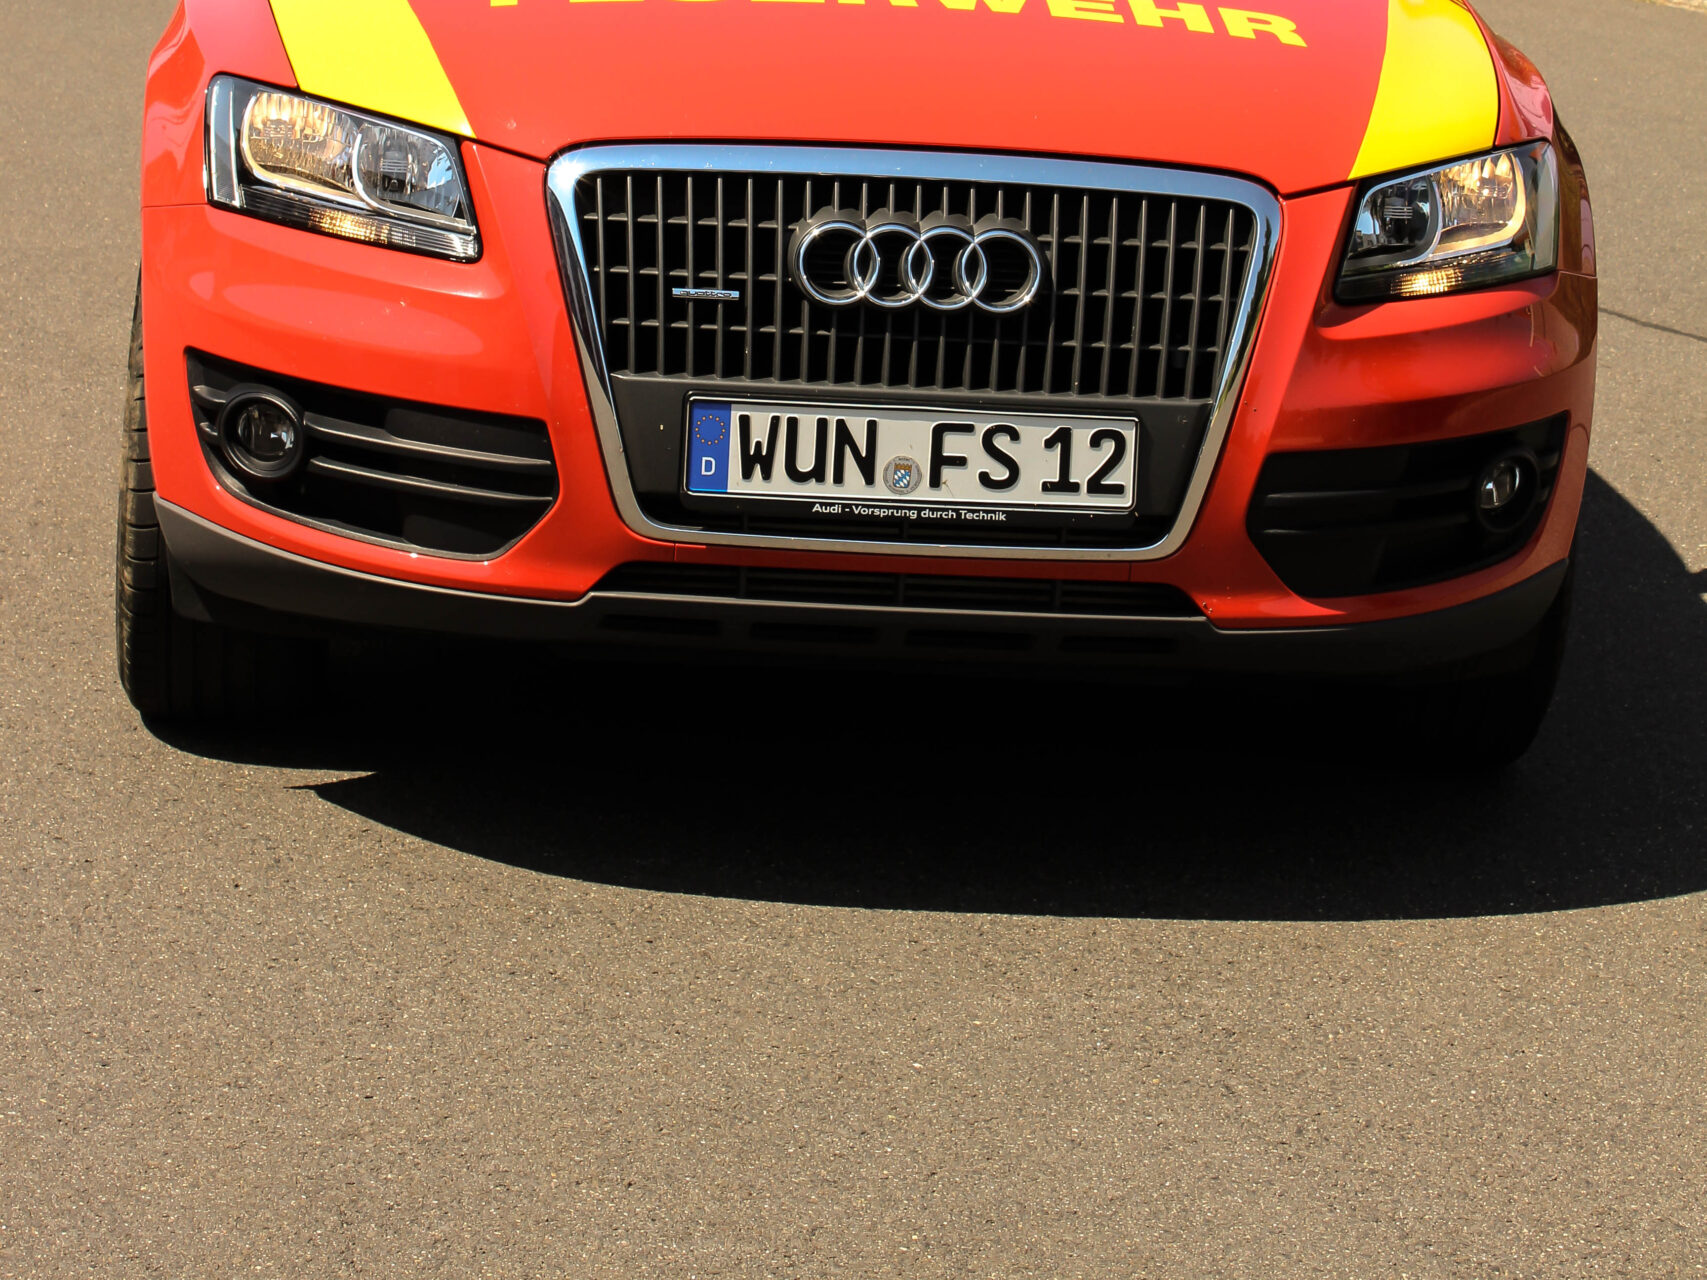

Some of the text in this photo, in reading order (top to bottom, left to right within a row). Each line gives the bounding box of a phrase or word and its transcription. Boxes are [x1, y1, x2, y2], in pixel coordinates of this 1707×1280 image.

[679, 289, 733, 298] quattro
[737, 413, 878, 485] WUN
[928, 422, 1021, 490] FS
[1040, 425, 1127, 495] 12
[701, 456, 716, 476] D
[811, 503, 842, 514] Audi
[852, 505, 918, 519] Vorsprung
[920, 508, 957, 519] durch
[959, 509, 1007, 522] Technik
